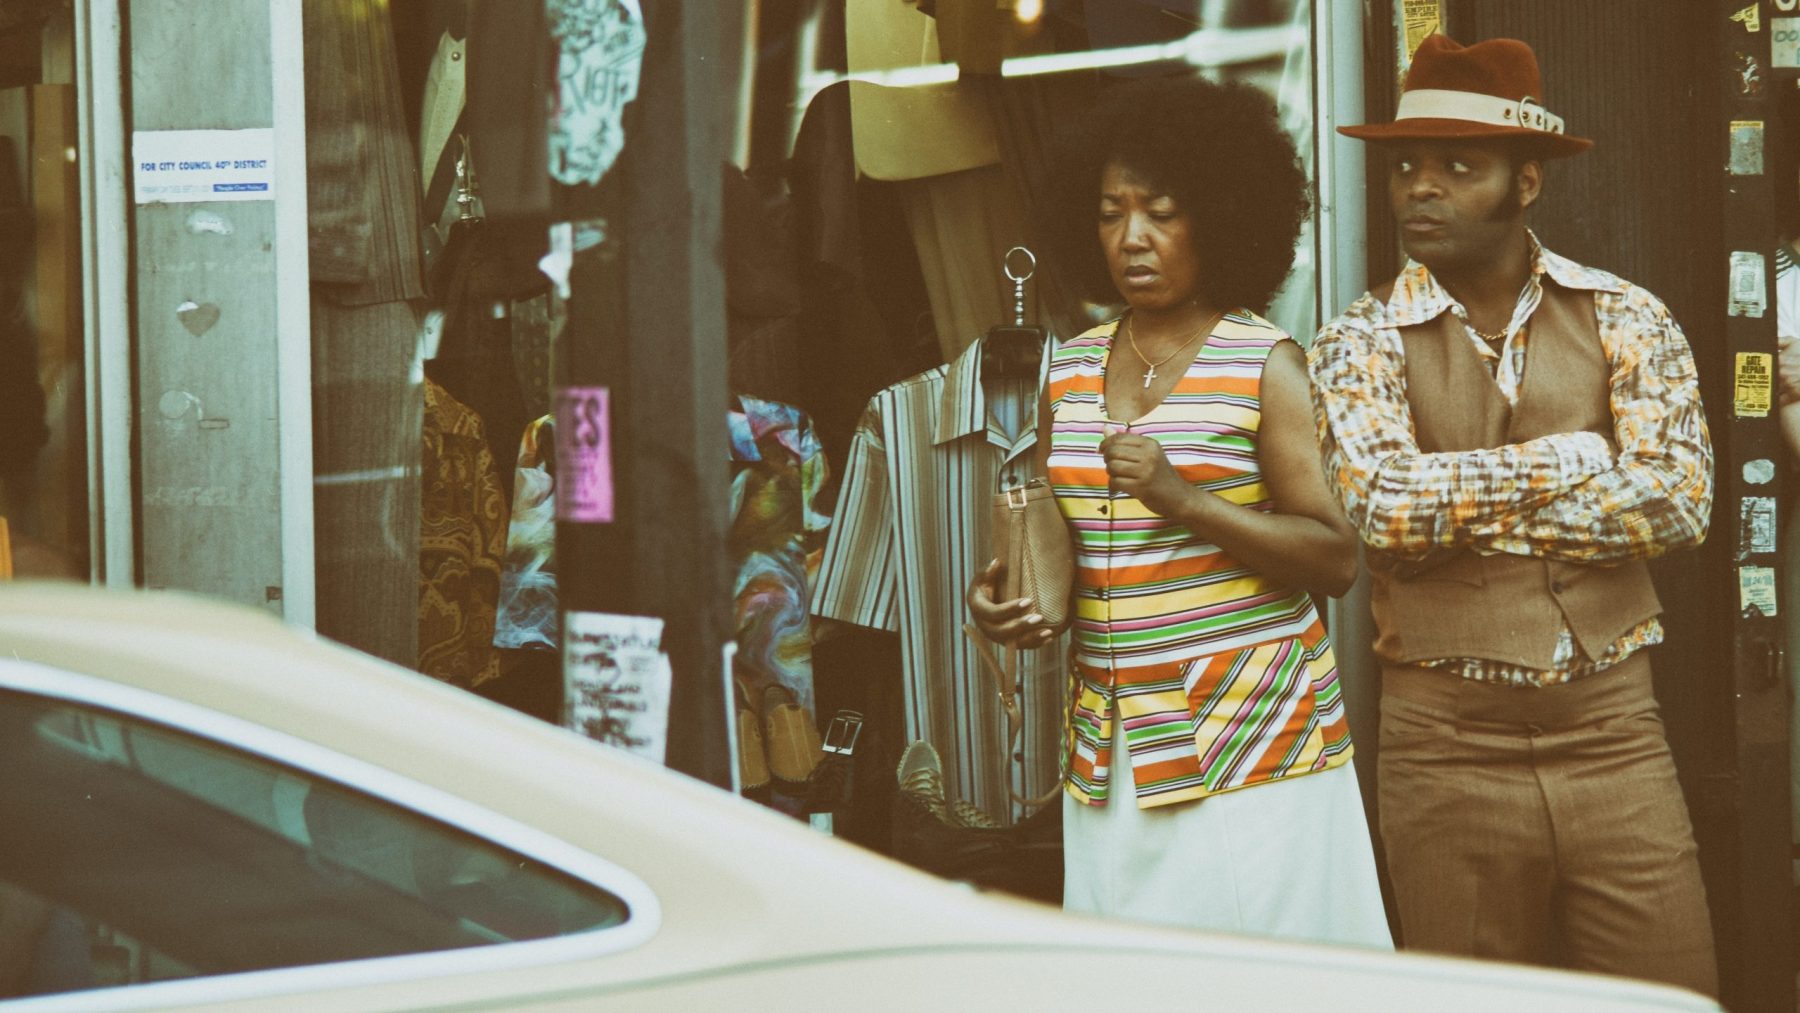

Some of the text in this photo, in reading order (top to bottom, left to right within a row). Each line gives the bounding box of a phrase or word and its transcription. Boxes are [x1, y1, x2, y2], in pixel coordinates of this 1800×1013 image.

[141, 162, 156, 172] FOR
[160, 161, 175, 171] CITY
[179, 161, 212, 170] COUNCIL
[234, 160, 267, 169] DISTRICT
[1741, 365, 1766, 374] REPAIR
